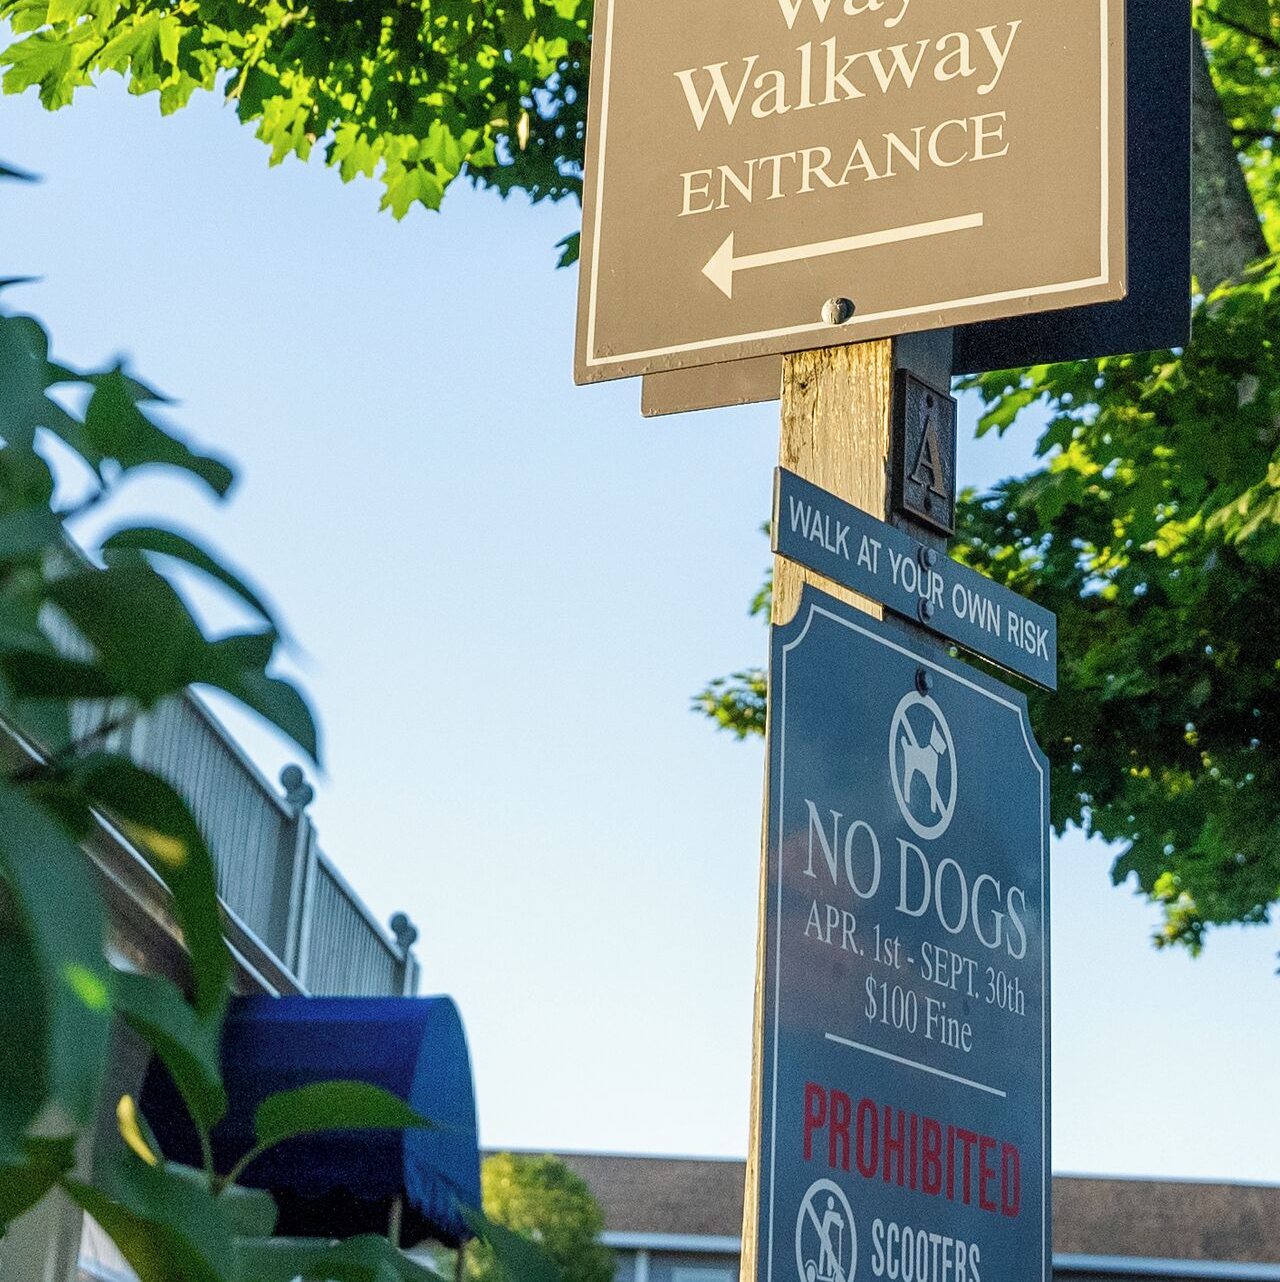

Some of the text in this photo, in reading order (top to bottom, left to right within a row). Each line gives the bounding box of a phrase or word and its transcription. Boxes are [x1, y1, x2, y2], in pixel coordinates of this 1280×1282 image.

[673, 19, 1023, 132] Walkway
[677, 110, 1010, 218] ENTRANCE
[911, 419, 946, 499] A
[788, 495, 1050, 661] WALK AT YOUR OWN RISK
[803, 798, 1027, 960] NO DOGS
[803, 898, 865, 957] APR.
[873, 923, 901, 969] 1st
[921, 941, 980, 999] SEPT.
[985, 966, 1026, 1017] 30th
[865, 972, 973, 1053] $100 Fine
[803, 1081, 1021, 1218] PROHIBITED
[871, 1218, 981, 1282] SCOOTERS
